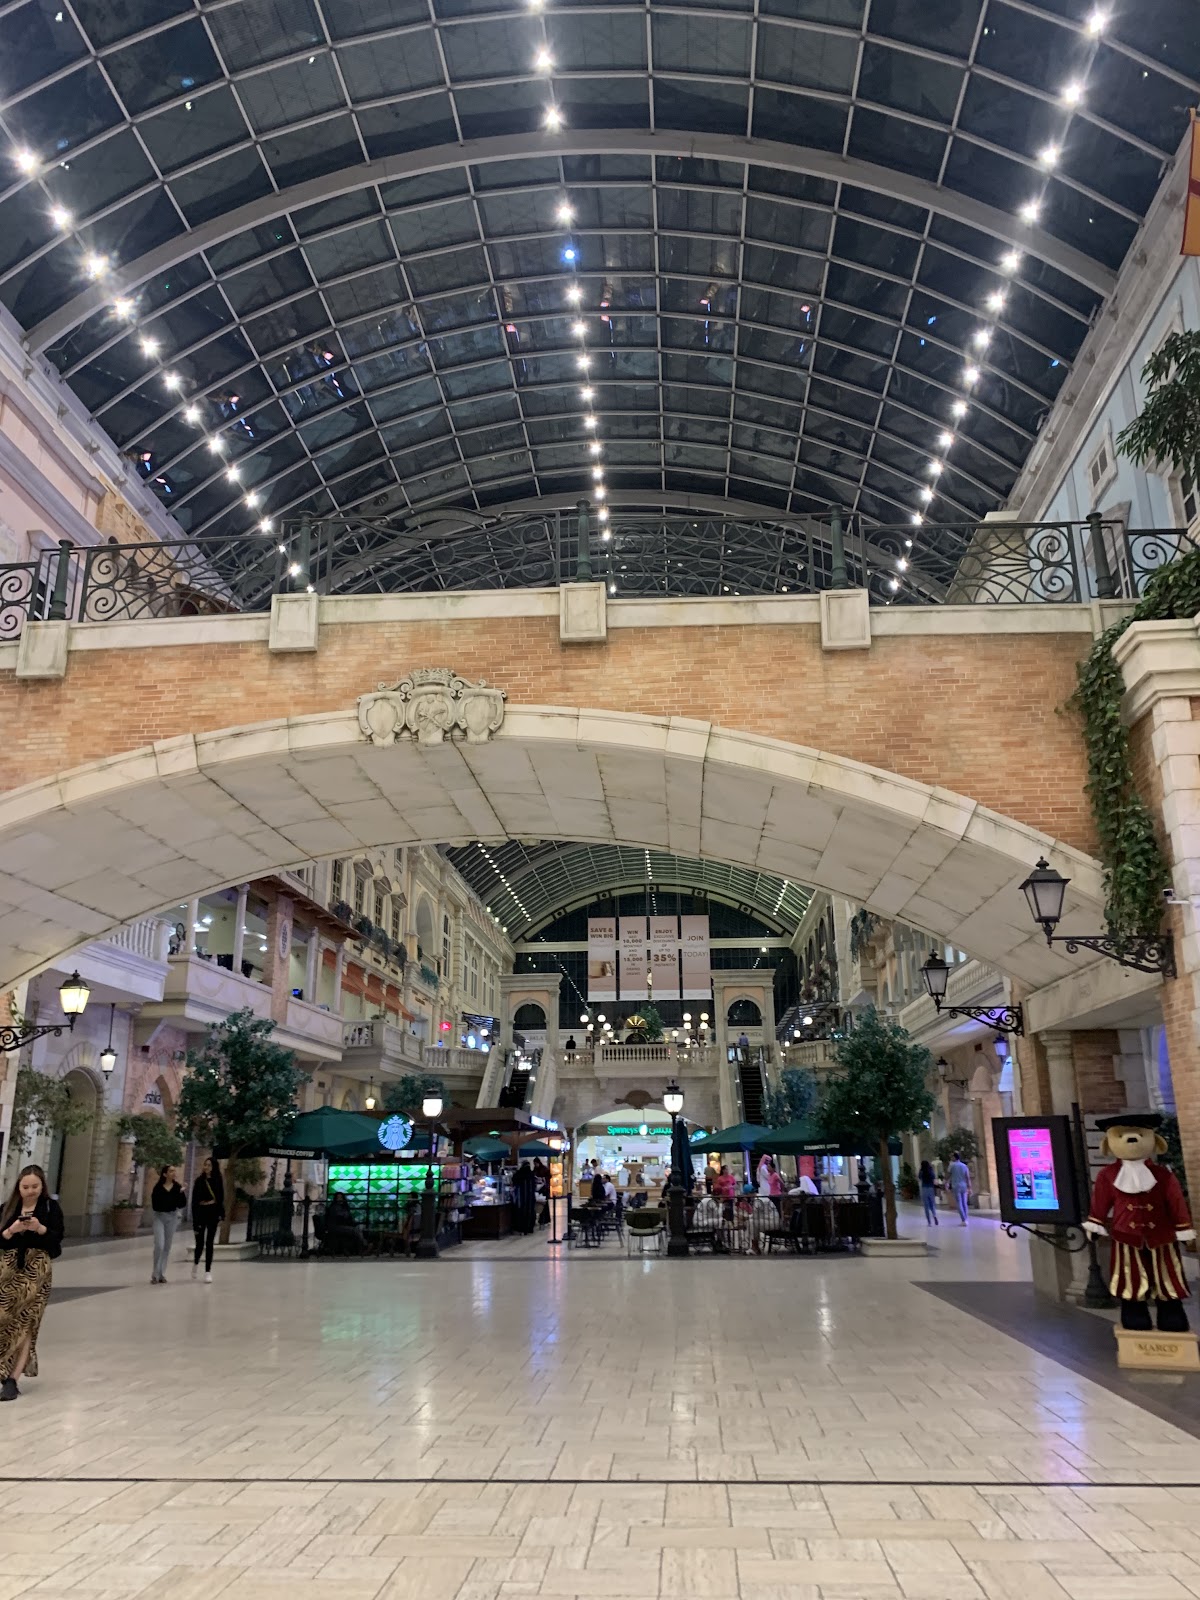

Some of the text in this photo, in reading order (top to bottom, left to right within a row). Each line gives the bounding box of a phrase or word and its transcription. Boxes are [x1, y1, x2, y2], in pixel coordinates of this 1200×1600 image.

[653, 954, 676, 962] 35%
[607, 1125, 638, 1135] Spinneys
[1137, 1343, 1179, 1353] MARCO
